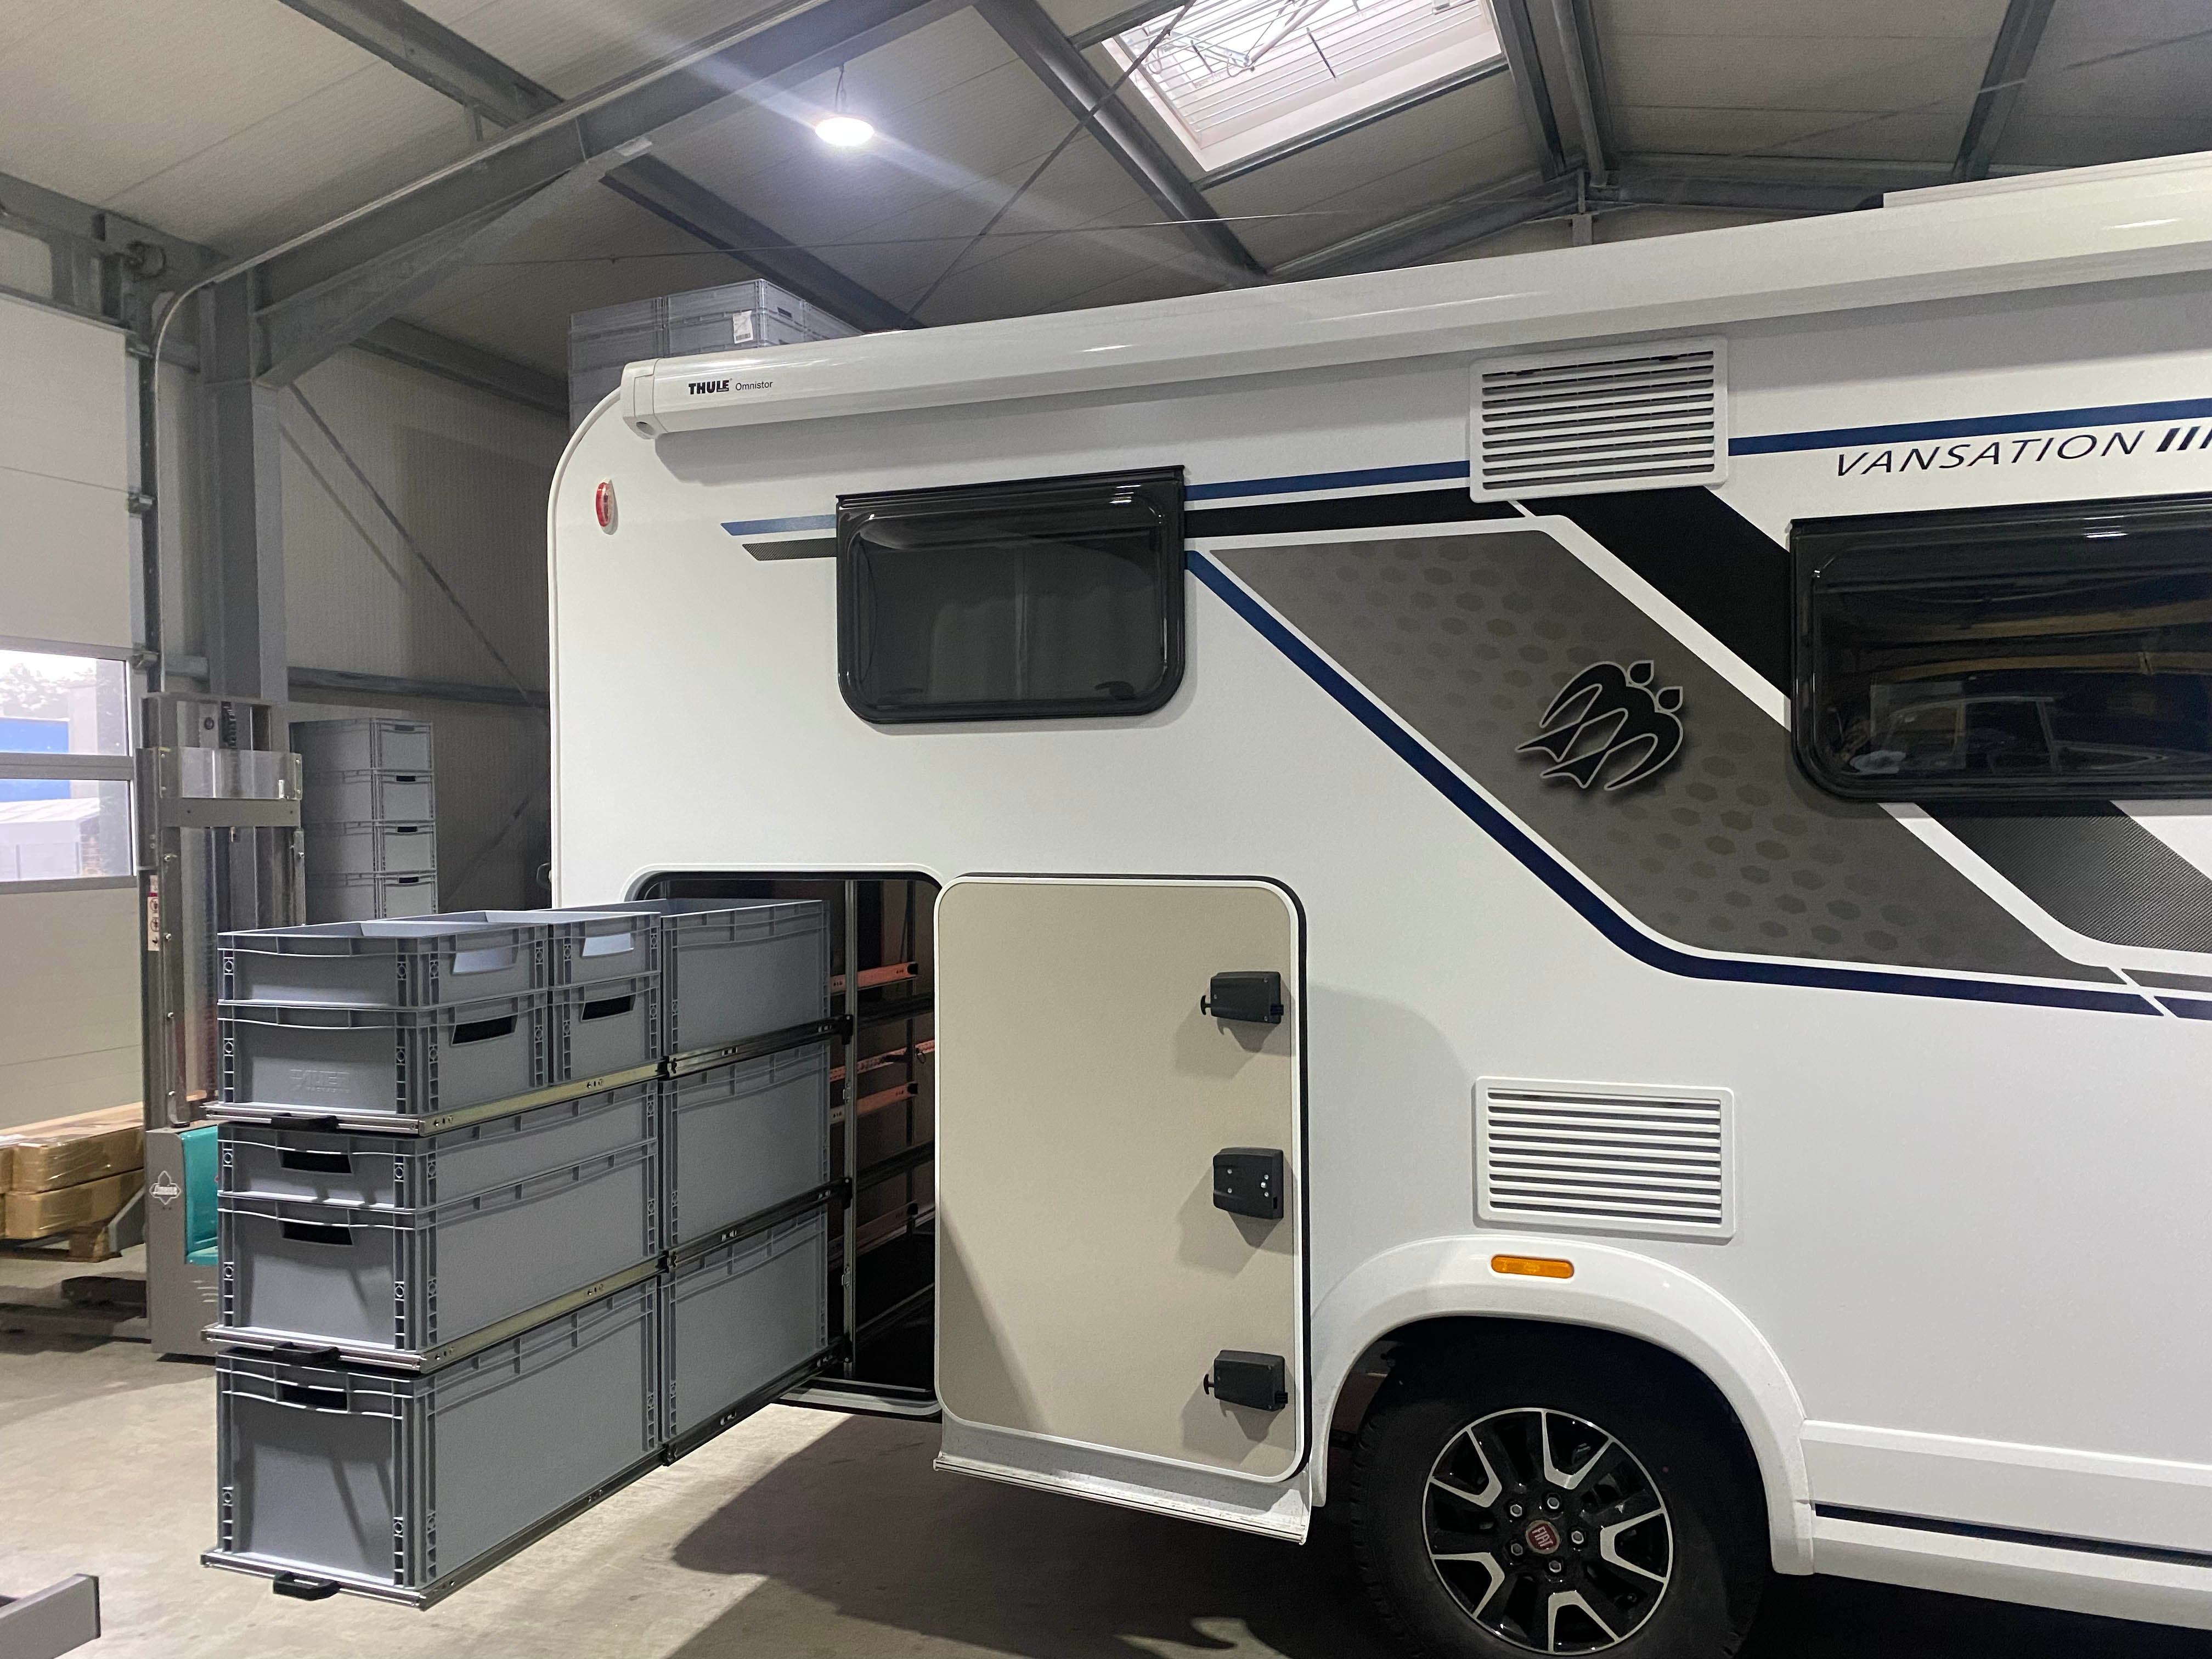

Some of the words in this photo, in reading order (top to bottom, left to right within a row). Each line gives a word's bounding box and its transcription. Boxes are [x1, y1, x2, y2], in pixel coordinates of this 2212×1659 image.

[689, 380, 729, 394] THULE
[736, 381, 773, 391] Omnistor
[1837, 431, 2145, 476] VANSATION
[1532, 1527, 1553, 1547] FIAT
